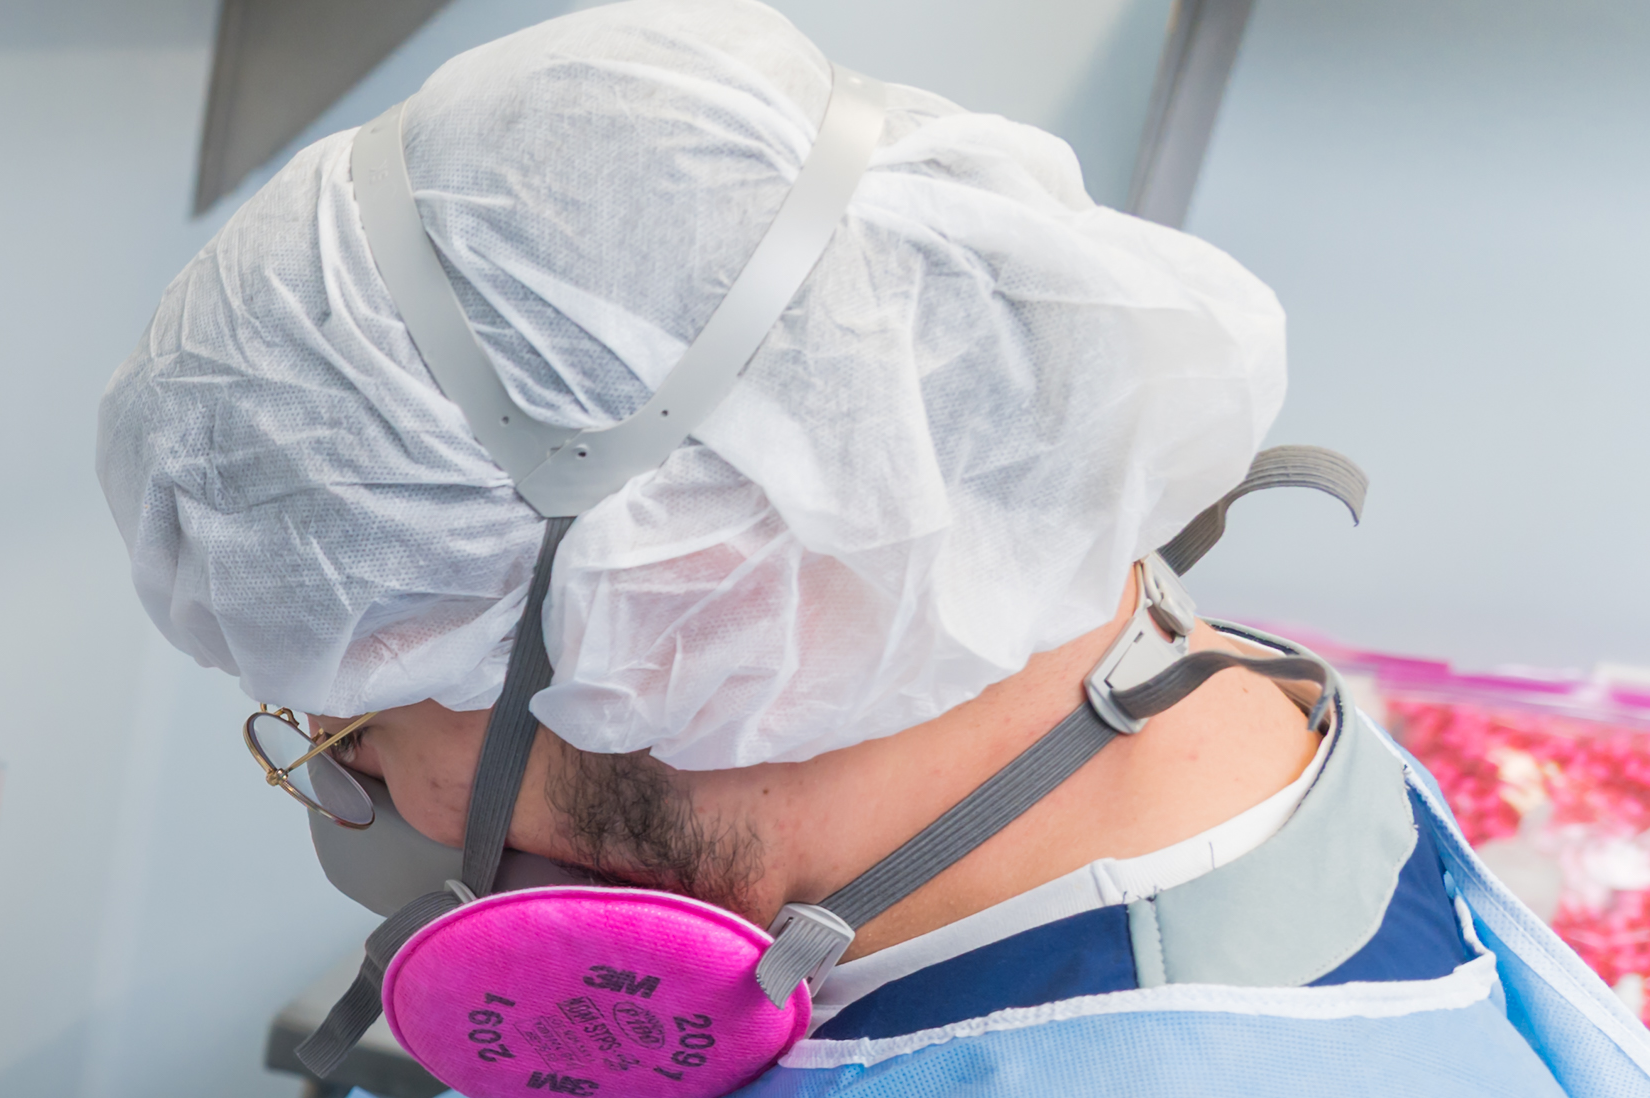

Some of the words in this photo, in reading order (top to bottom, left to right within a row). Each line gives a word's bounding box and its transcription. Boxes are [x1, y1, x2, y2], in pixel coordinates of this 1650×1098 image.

[583, 964, 662, 998] 3M
[468, 992, 516, 1063] 2091
[654, 1013, 716, 1081] 2091
[526, 1071, 600, 1097] 3M
